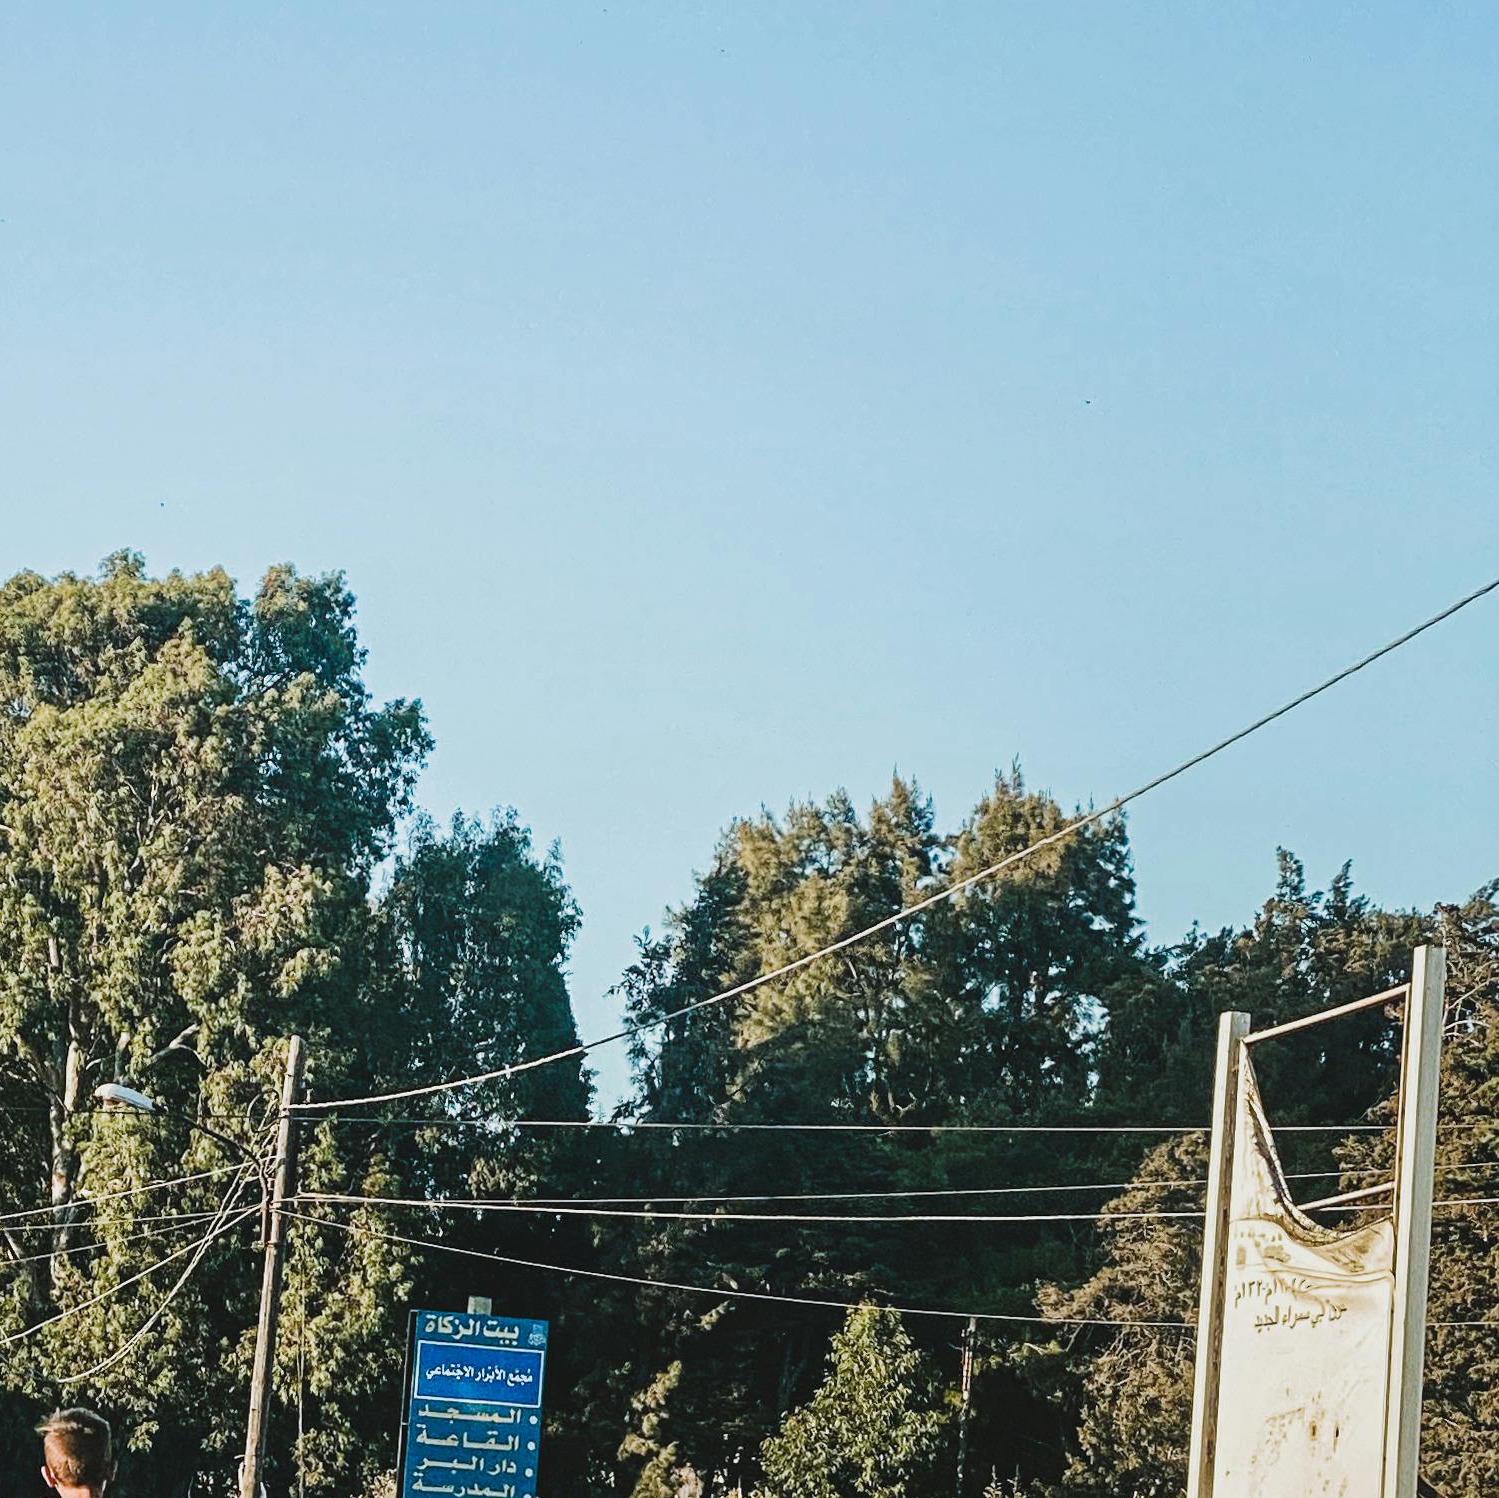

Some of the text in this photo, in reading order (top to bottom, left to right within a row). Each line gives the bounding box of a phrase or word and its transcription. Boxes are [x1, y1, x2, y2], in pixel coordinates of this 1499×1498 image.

[425, 1314, 519, 1346] بيت الزكاة
[418, 1403, 522, 1424] المسجد
[416, 1424, 520, 1452] القاعة
[416, 1456, 517, 1476] دار البر
[412, 1471, 516, 1498] المدرسة
